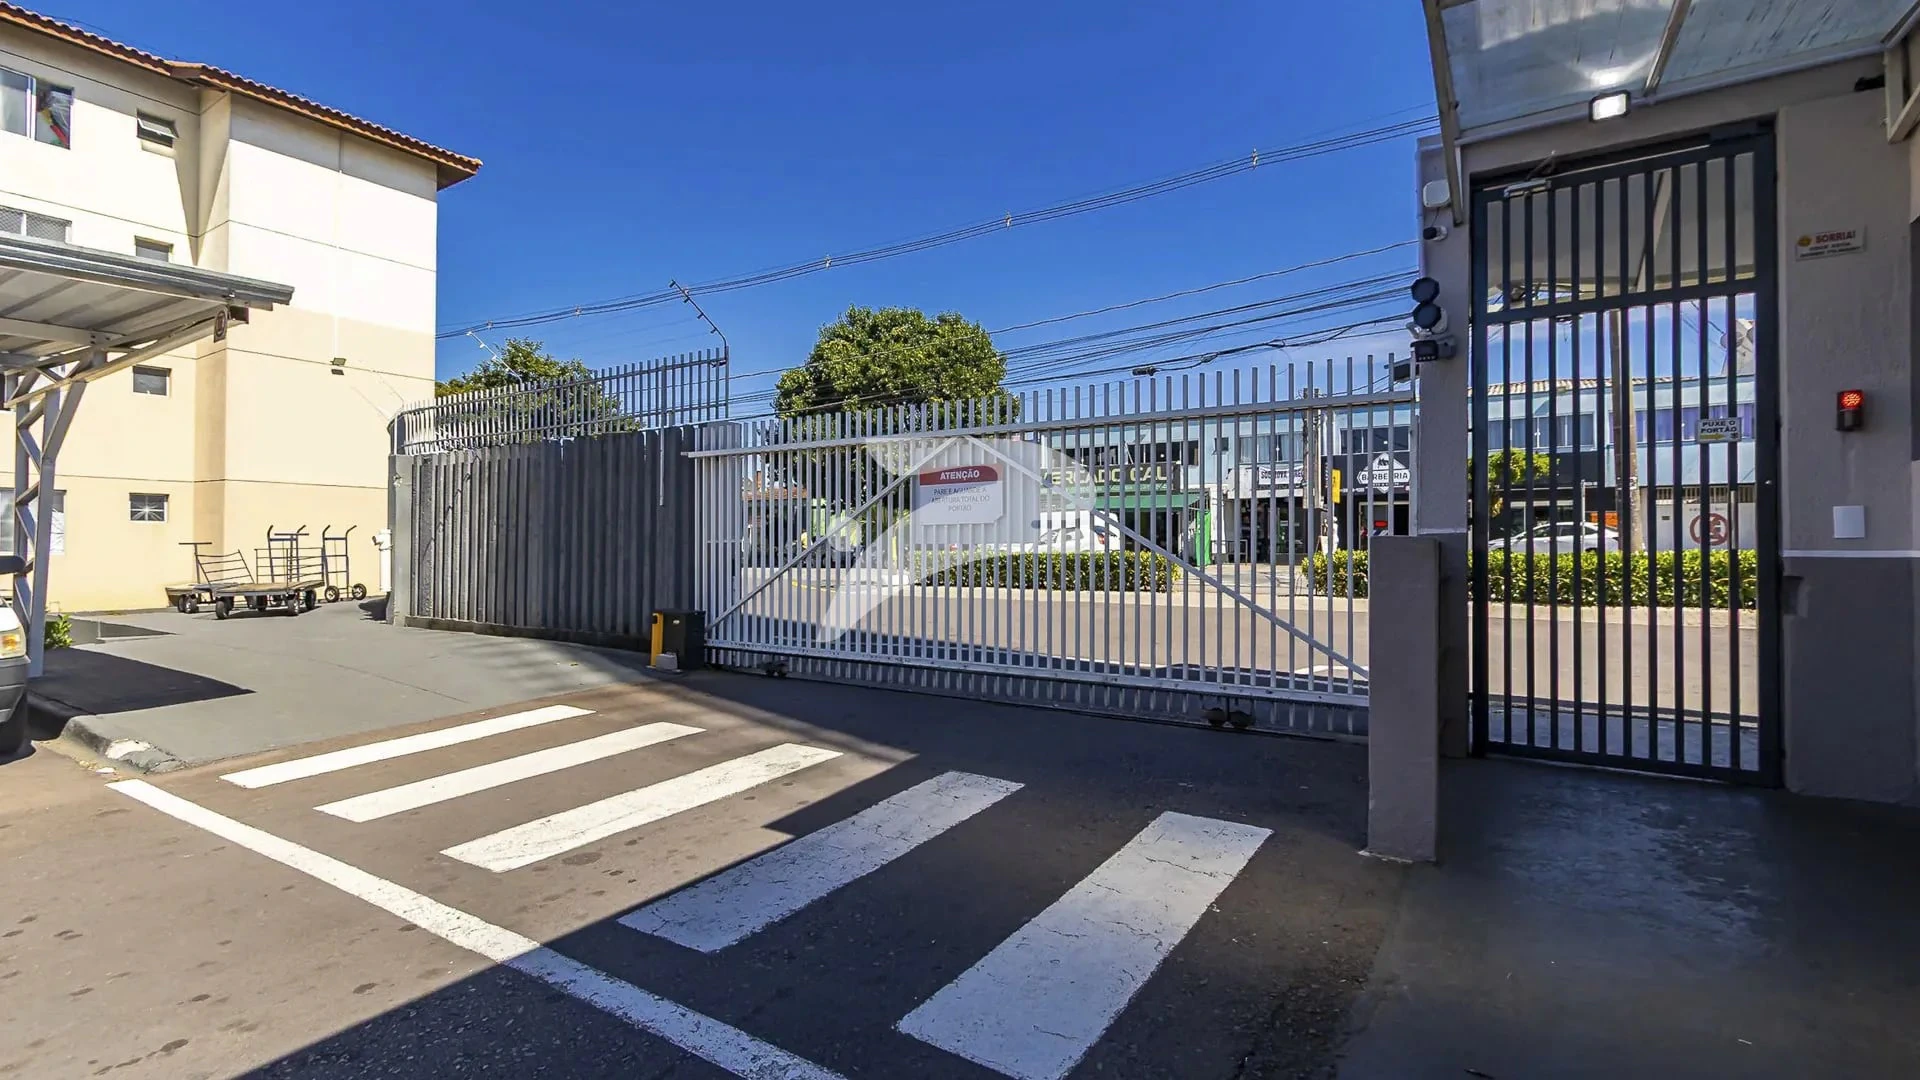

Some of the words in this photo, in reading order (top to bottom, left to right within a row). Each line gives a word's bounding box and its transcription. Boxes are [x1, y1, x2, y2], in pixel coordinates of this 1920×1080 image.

[1701, 425, 1738, 434] PORTÃO
[940, 468, 980, 481] ATENÇÃO
[1042, 469, 1125, 484] ERCADO
[1361, 472, 1409, 481] BRBERIA
[933, 488, 947, 496] PARE
